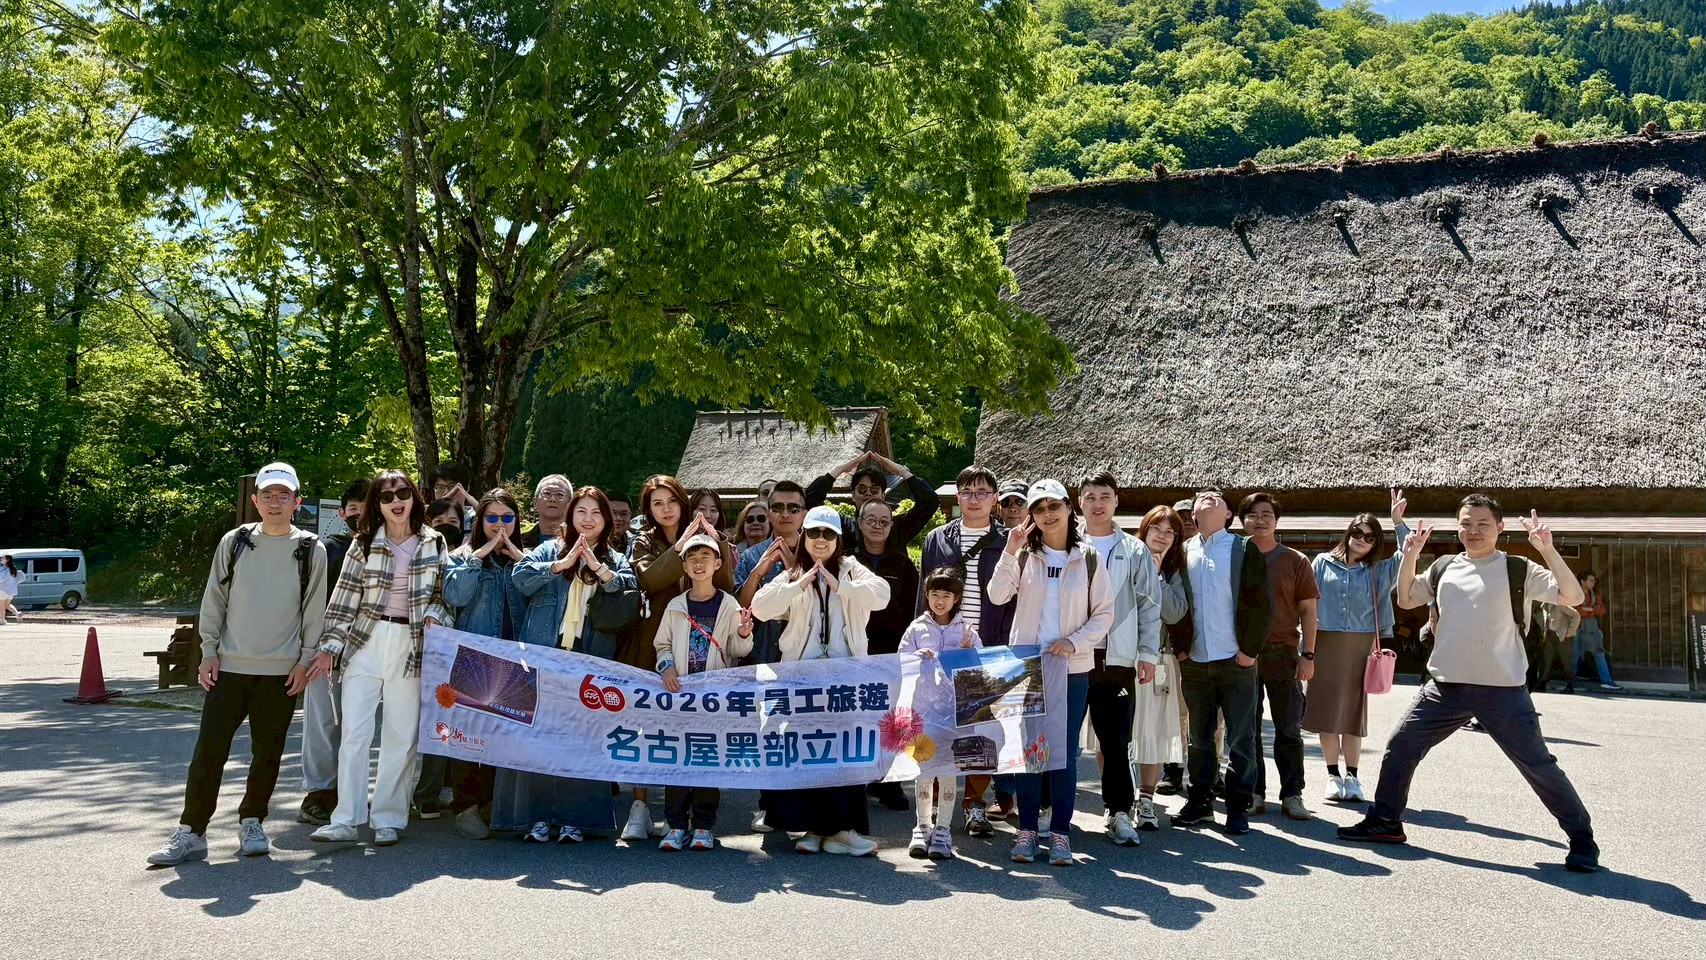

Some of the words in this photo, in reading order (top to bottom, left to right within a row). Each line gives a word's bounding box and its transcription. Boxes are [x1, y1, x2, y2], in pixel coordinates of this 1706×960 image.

[633, 682, 890, 718] 2026年員工旅遊
[607, 725, 876, 768] 名古屋黑部立山
